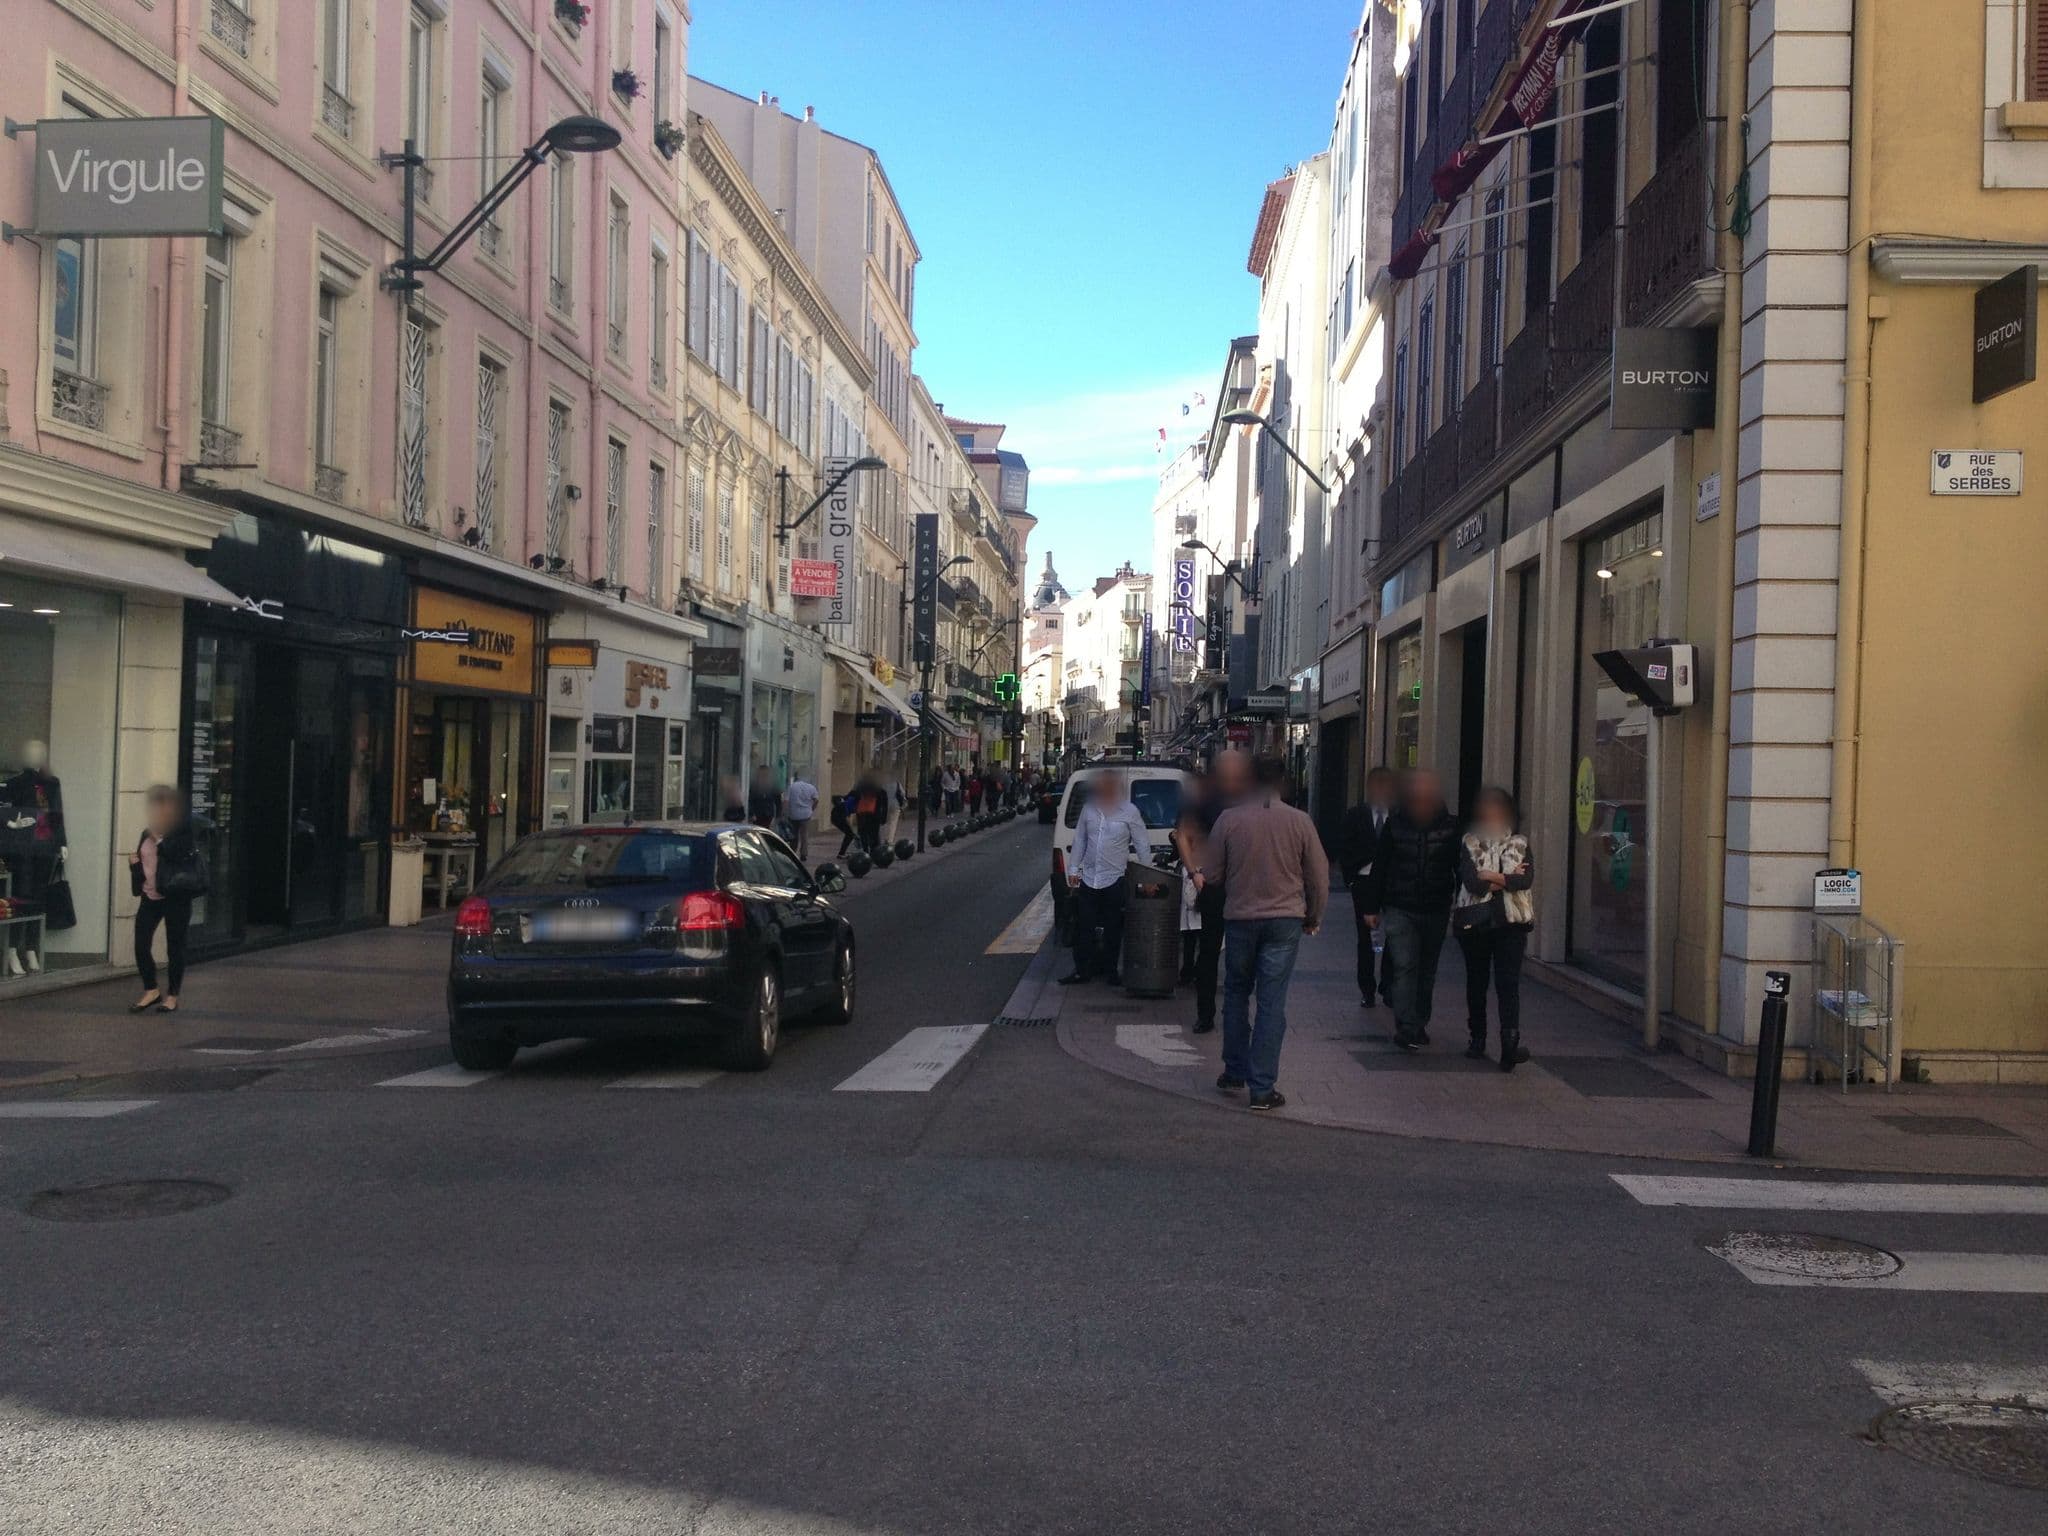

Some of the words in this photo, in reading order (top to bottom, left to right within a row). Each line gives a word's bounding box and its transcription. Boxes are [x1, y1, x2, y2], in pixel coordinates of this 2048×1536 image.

[47, 147, 206, 205] Virgule
[1977, 318, 2022, 352] BURTON
[1622, 371, 1709, 384] BURTON
[1969, 455, 1996, 465] RUE
[1972, 467, 1993, 476] des
[1949, 478, 2011, 489] SERBES
[1456, 513, 1483, 549] BURTON
[802, 568, 832, 579] VENDRE
[1824, 879, 1852, 888] LOGIC
